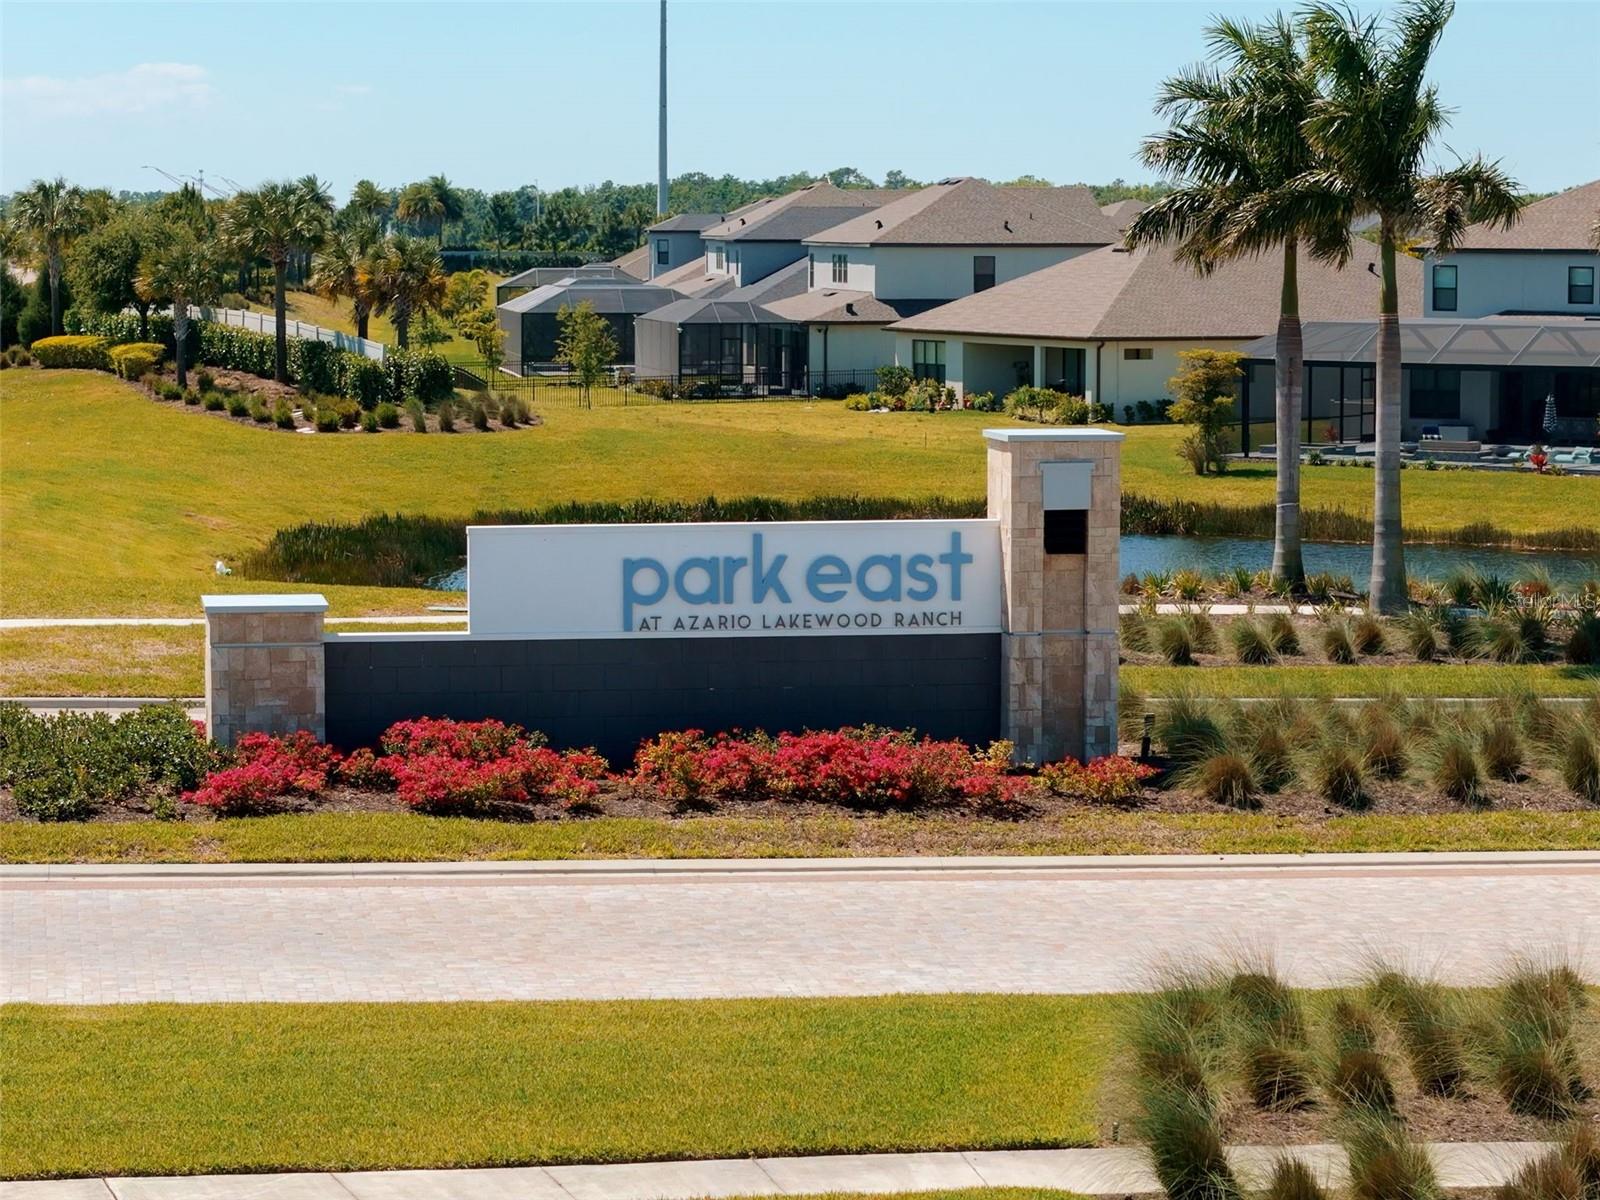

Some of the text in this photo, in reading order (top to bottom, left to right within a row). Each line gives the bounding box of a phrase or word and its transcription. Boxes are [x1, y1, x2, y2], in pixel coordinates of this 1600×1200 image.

[623, 531, 973, 632] park east
[639, 611, 962, 631] AT AZARIO LAKEWOOD RANCH
